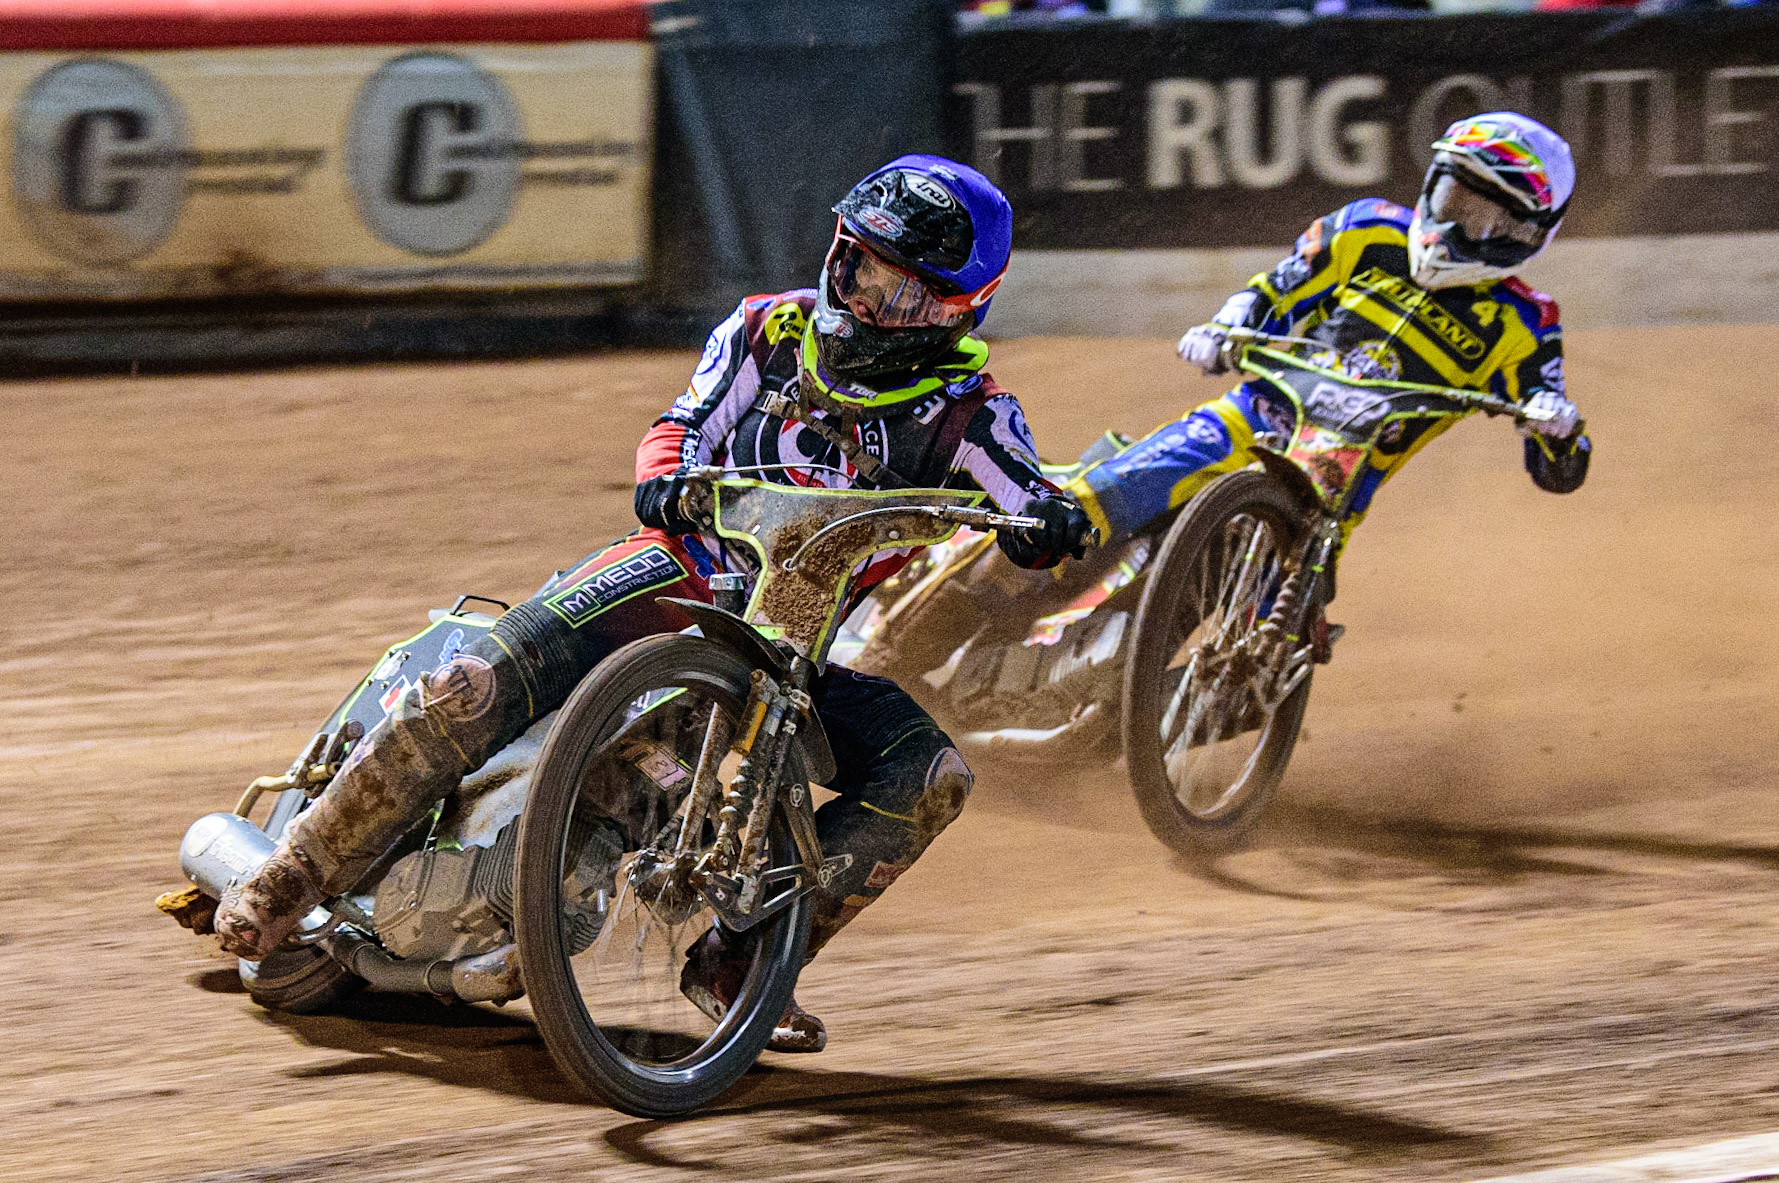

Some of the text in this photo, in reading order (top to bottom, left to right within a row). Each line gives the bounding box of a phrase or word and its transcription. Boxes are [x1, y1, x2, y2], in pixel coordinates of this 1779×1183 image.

[1147, 74, 1389, 189] RUG
[1405, 65, 1779, 178] OUTLE
[583, 549, 671, 597] MEDD
[596, 565, 678, 603] CONSTRUCTION
